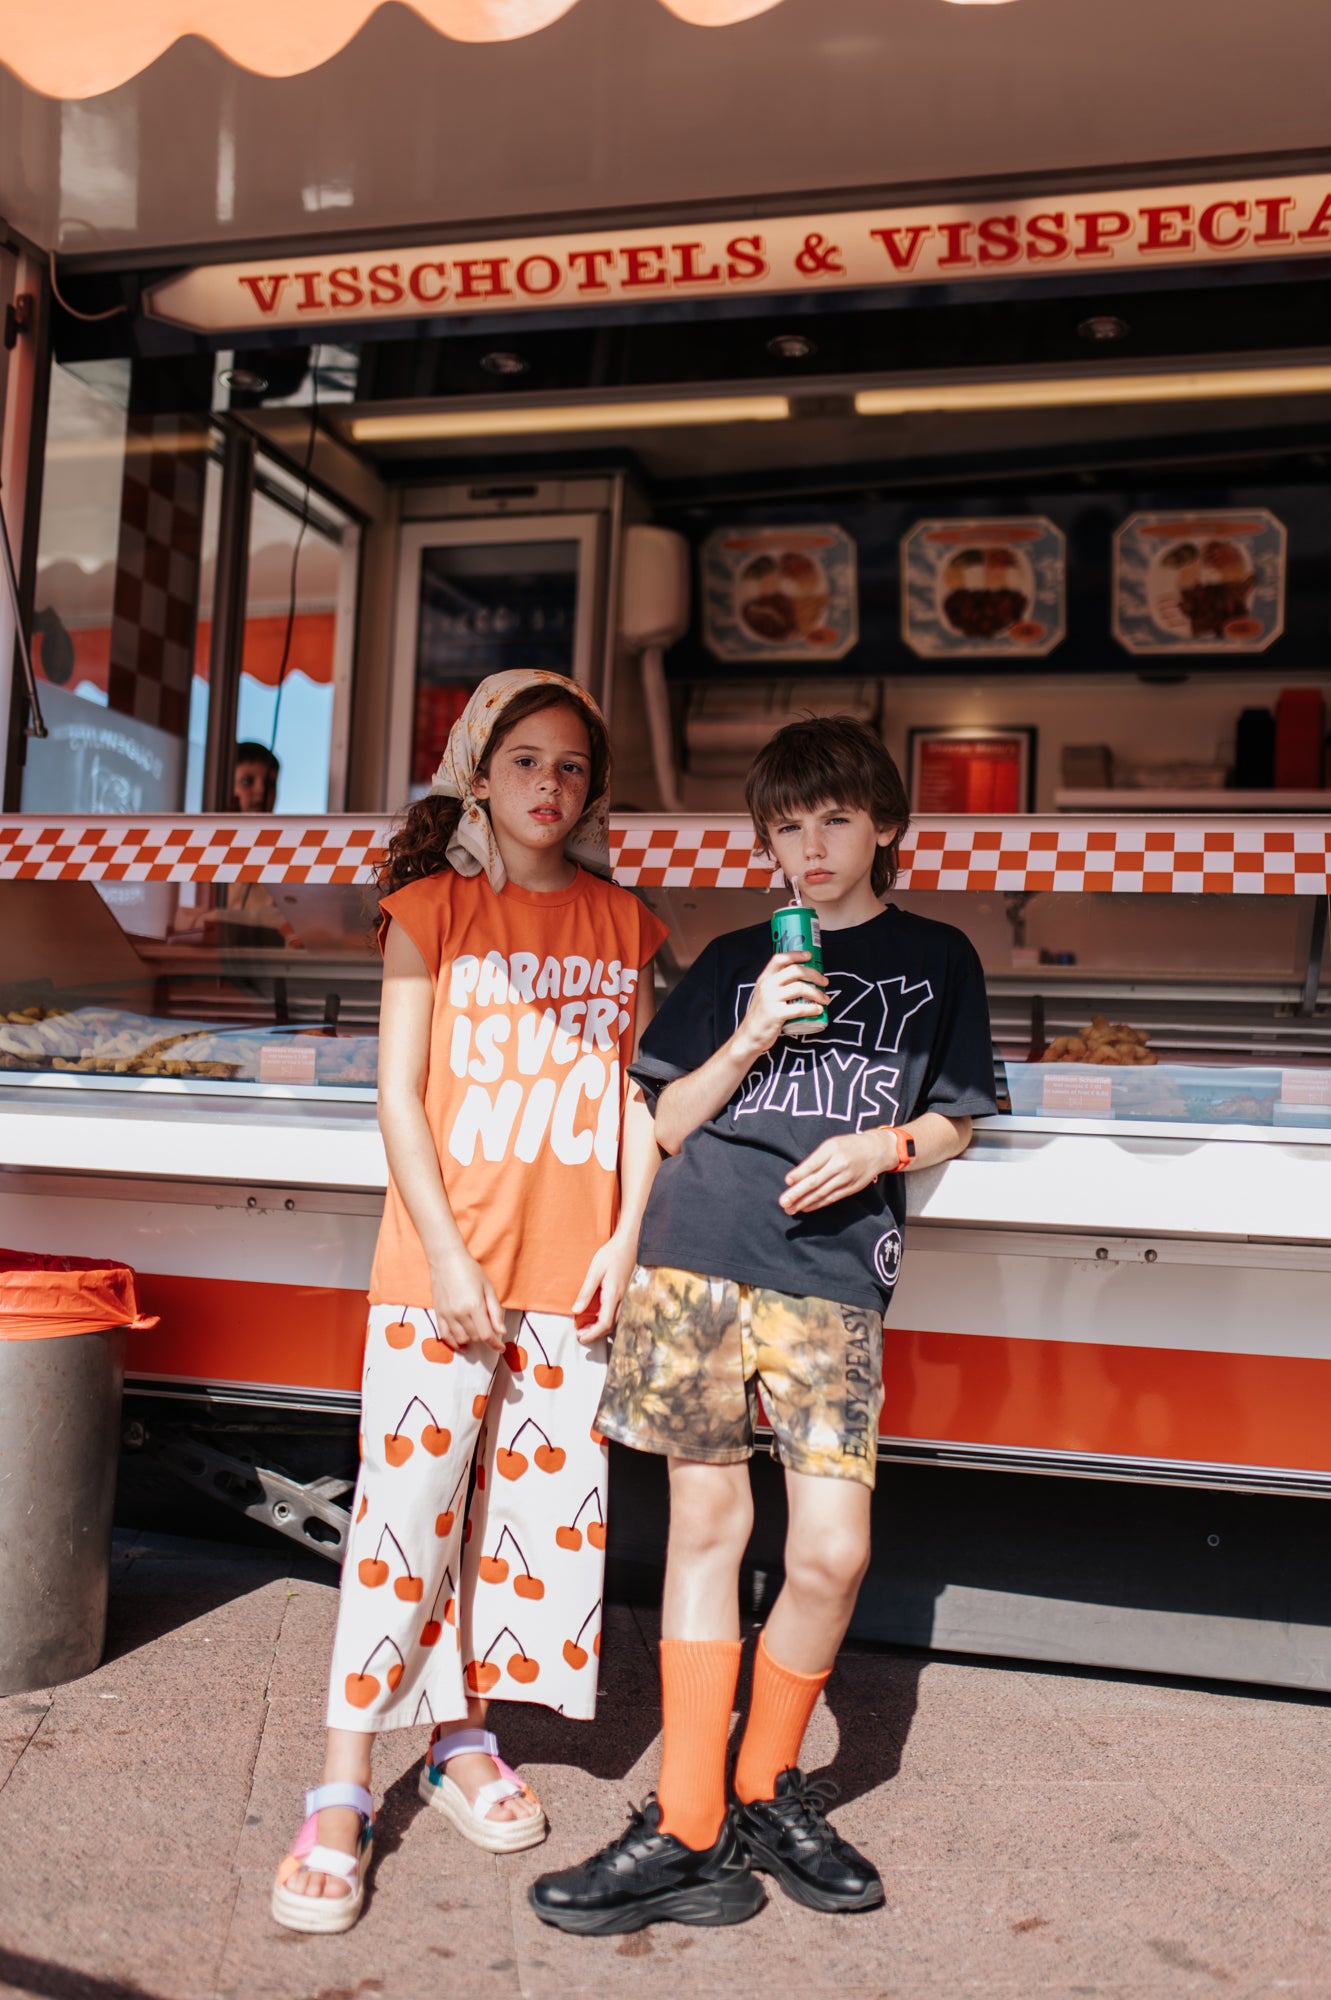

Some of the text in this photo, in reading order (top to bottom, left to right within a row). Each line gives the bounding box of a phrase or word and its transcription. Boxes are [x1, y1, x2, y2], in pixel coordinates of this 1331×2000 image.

[238, 236, 766, 312] VISSCHOTELS
[795, 234, 844, 275] &
[450, 1014, 511, 1083] IS
[734, 1046, 899, 1134] DAYS
